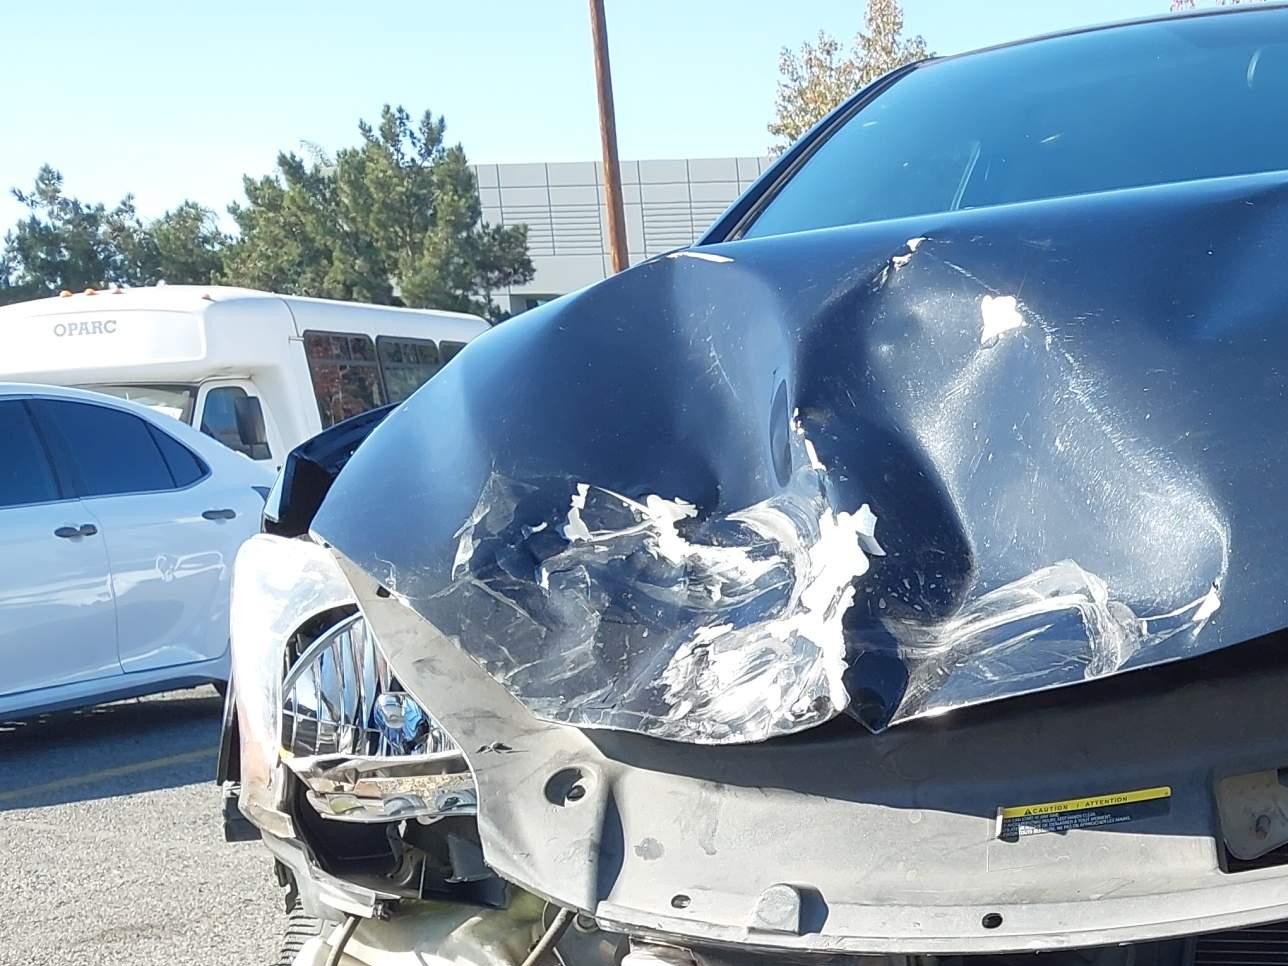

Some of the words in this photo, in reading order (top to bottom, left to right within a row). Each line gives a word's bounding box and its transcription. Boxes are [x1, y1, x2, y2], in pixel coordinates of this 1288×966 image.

[53, 319, 118, 337] OPARC
[1032, 804, 1069, 814] CAUTION
[1085, 796, 1129, 807] ATTENTION
